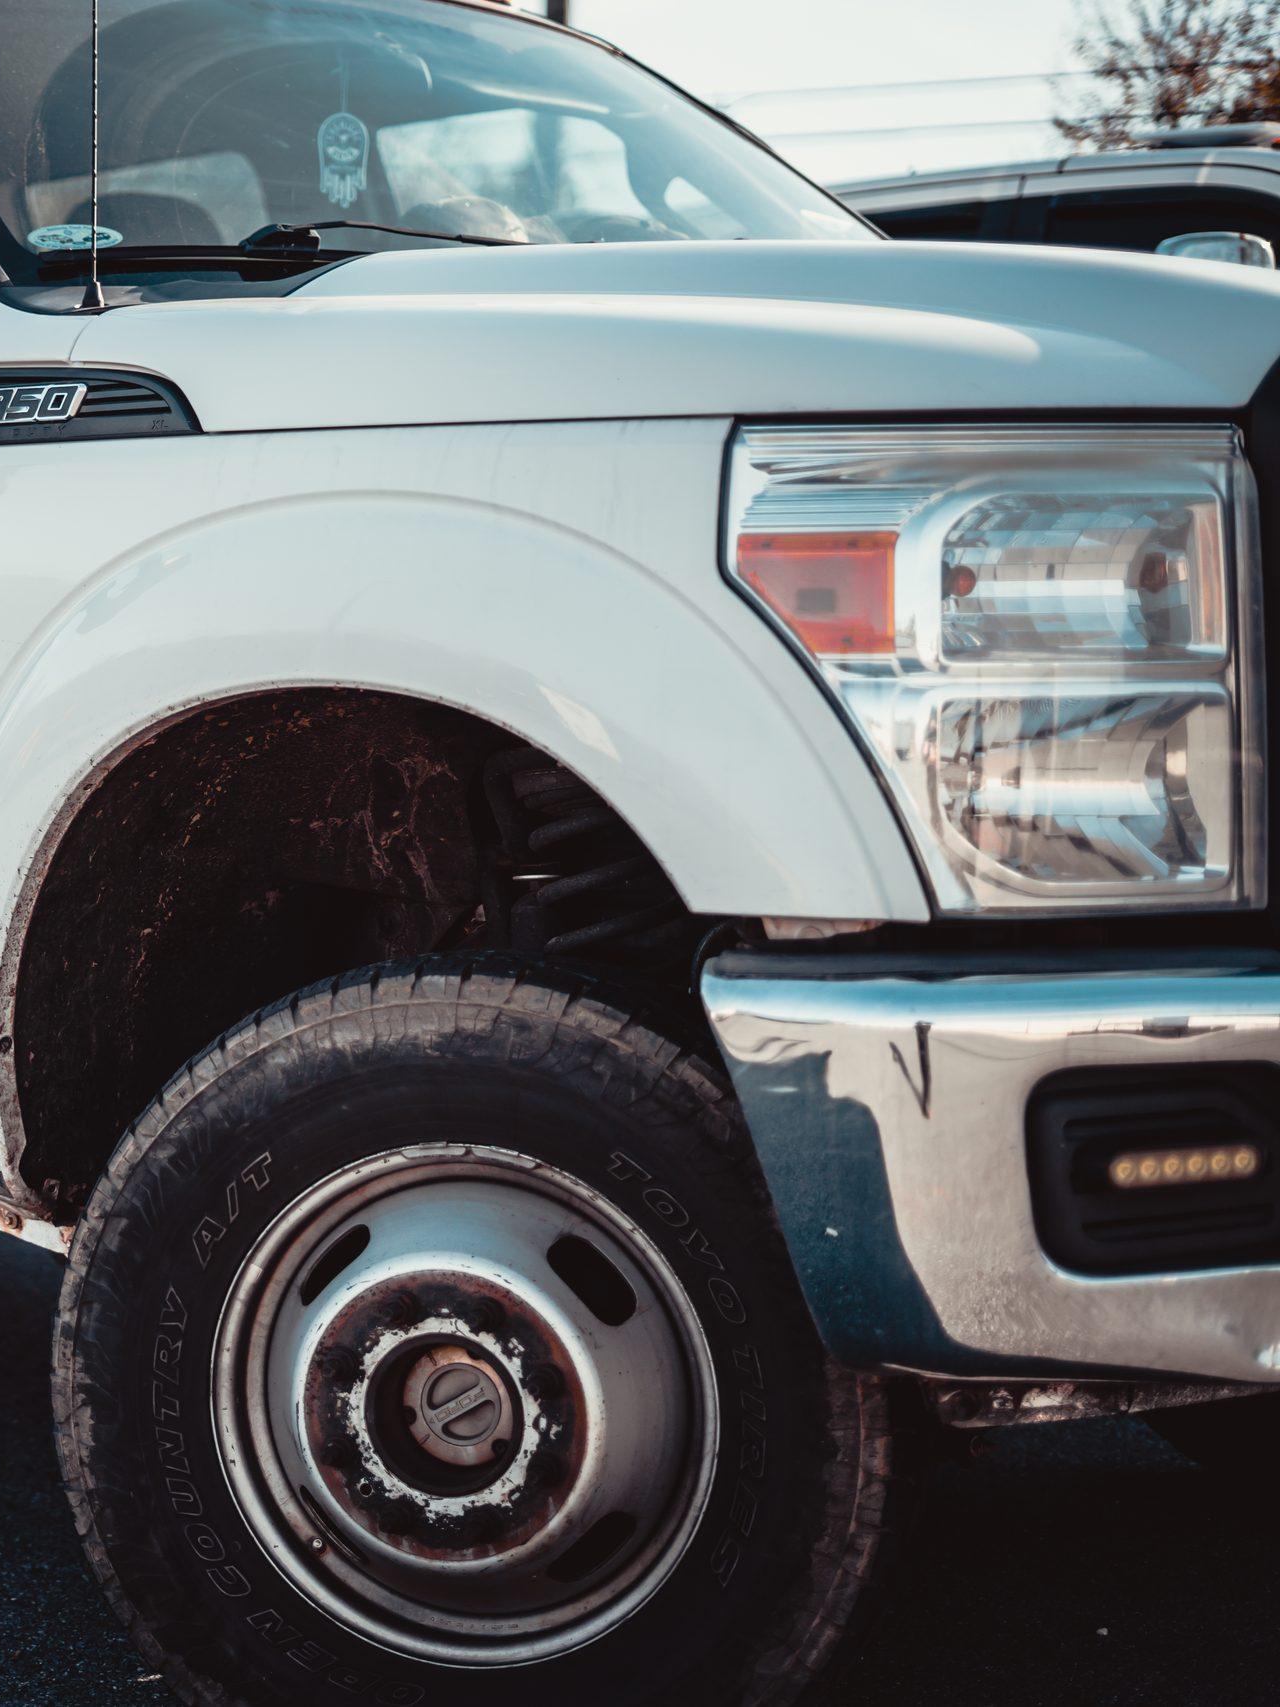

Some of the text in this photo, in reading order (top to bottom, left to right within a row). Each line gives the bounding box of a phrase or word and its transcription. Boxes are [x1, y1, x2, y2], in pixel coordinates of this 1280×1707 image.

[152, 1151, 426, 1706] OPEN COUNTRY A/T
[607, 1152, 766, 1589] TOYO TIRES
